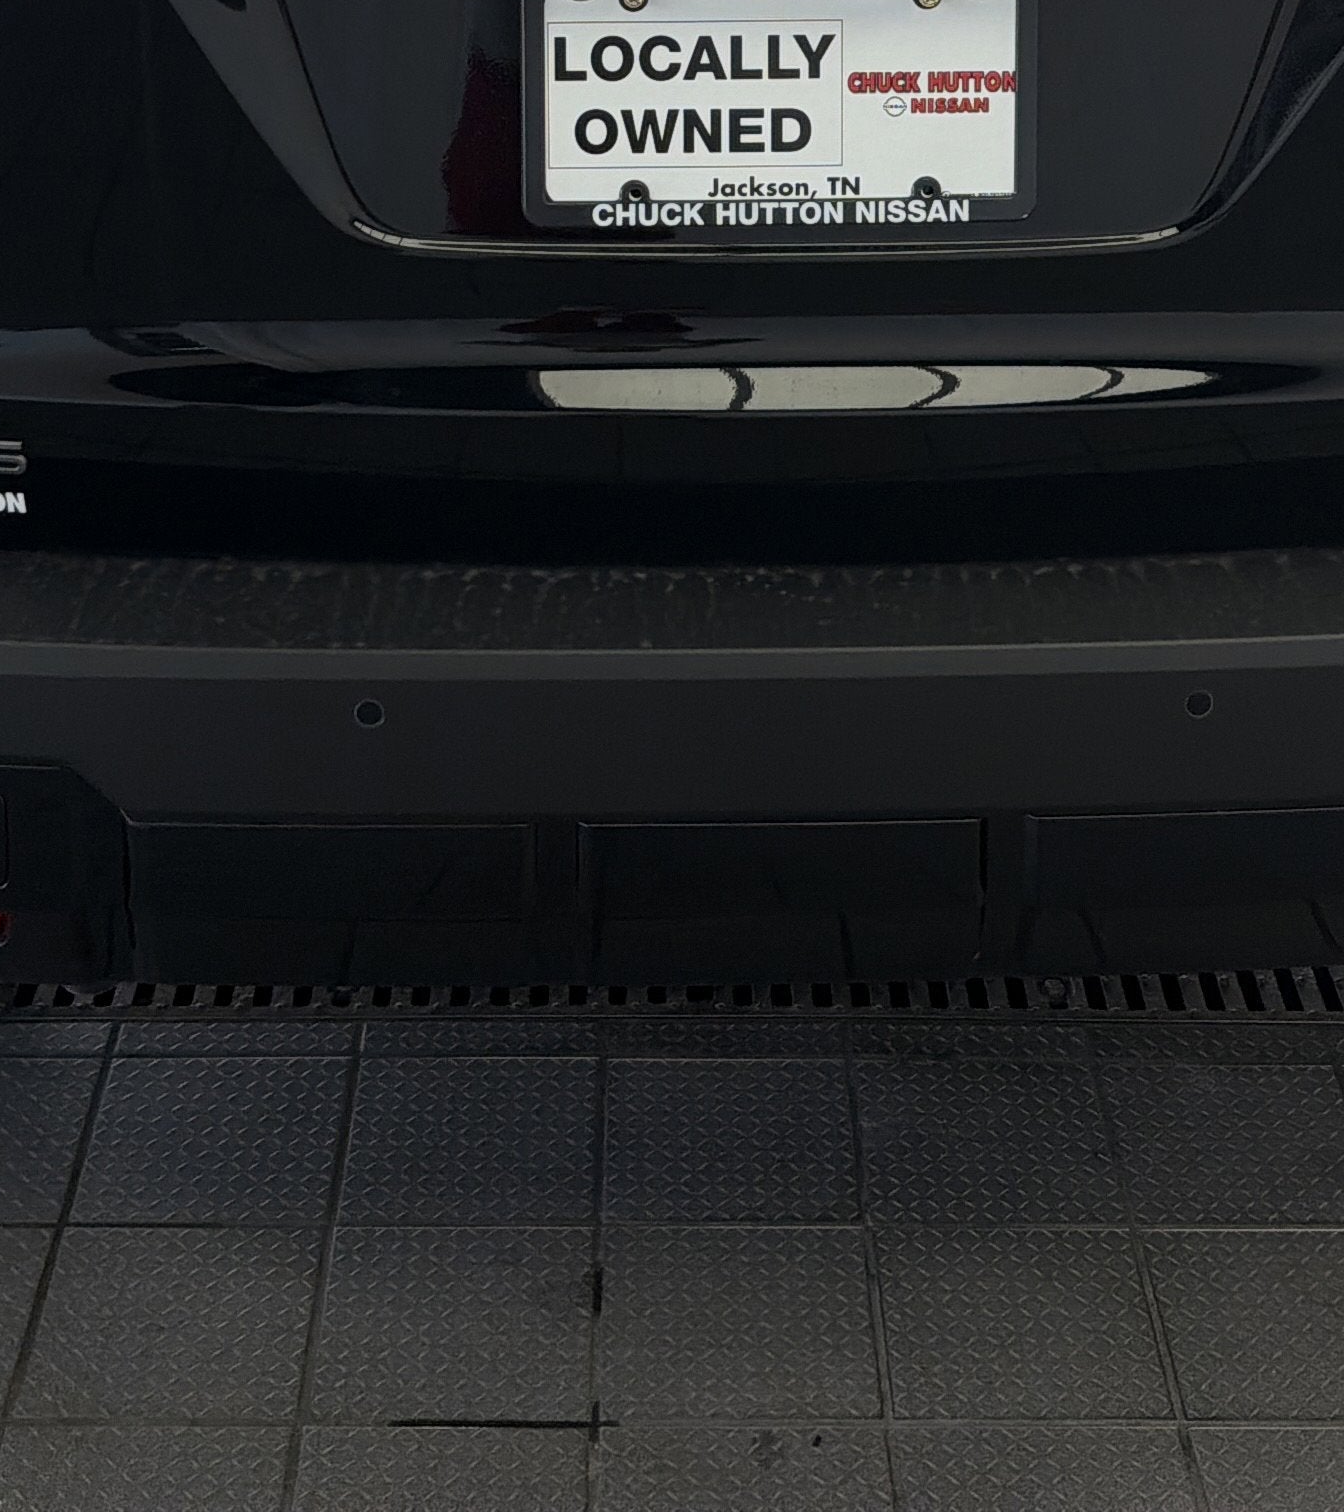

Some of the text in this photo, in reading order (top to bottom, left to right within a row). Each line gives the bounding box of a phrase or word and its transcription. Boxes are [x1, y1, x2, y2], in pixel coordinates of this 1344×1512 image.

[553, 33, 836, 82] LOCALLY
[847, 70, 1017, 94] CHUCK HUTTON
[910, 97, 990, 114] NISSAN
[574, 108, 812, 155] OWNED
[708, 176, 861, 200] Jackson, TN
[592, 199, 970, 227] CHUCK HUTTON NISSAN
